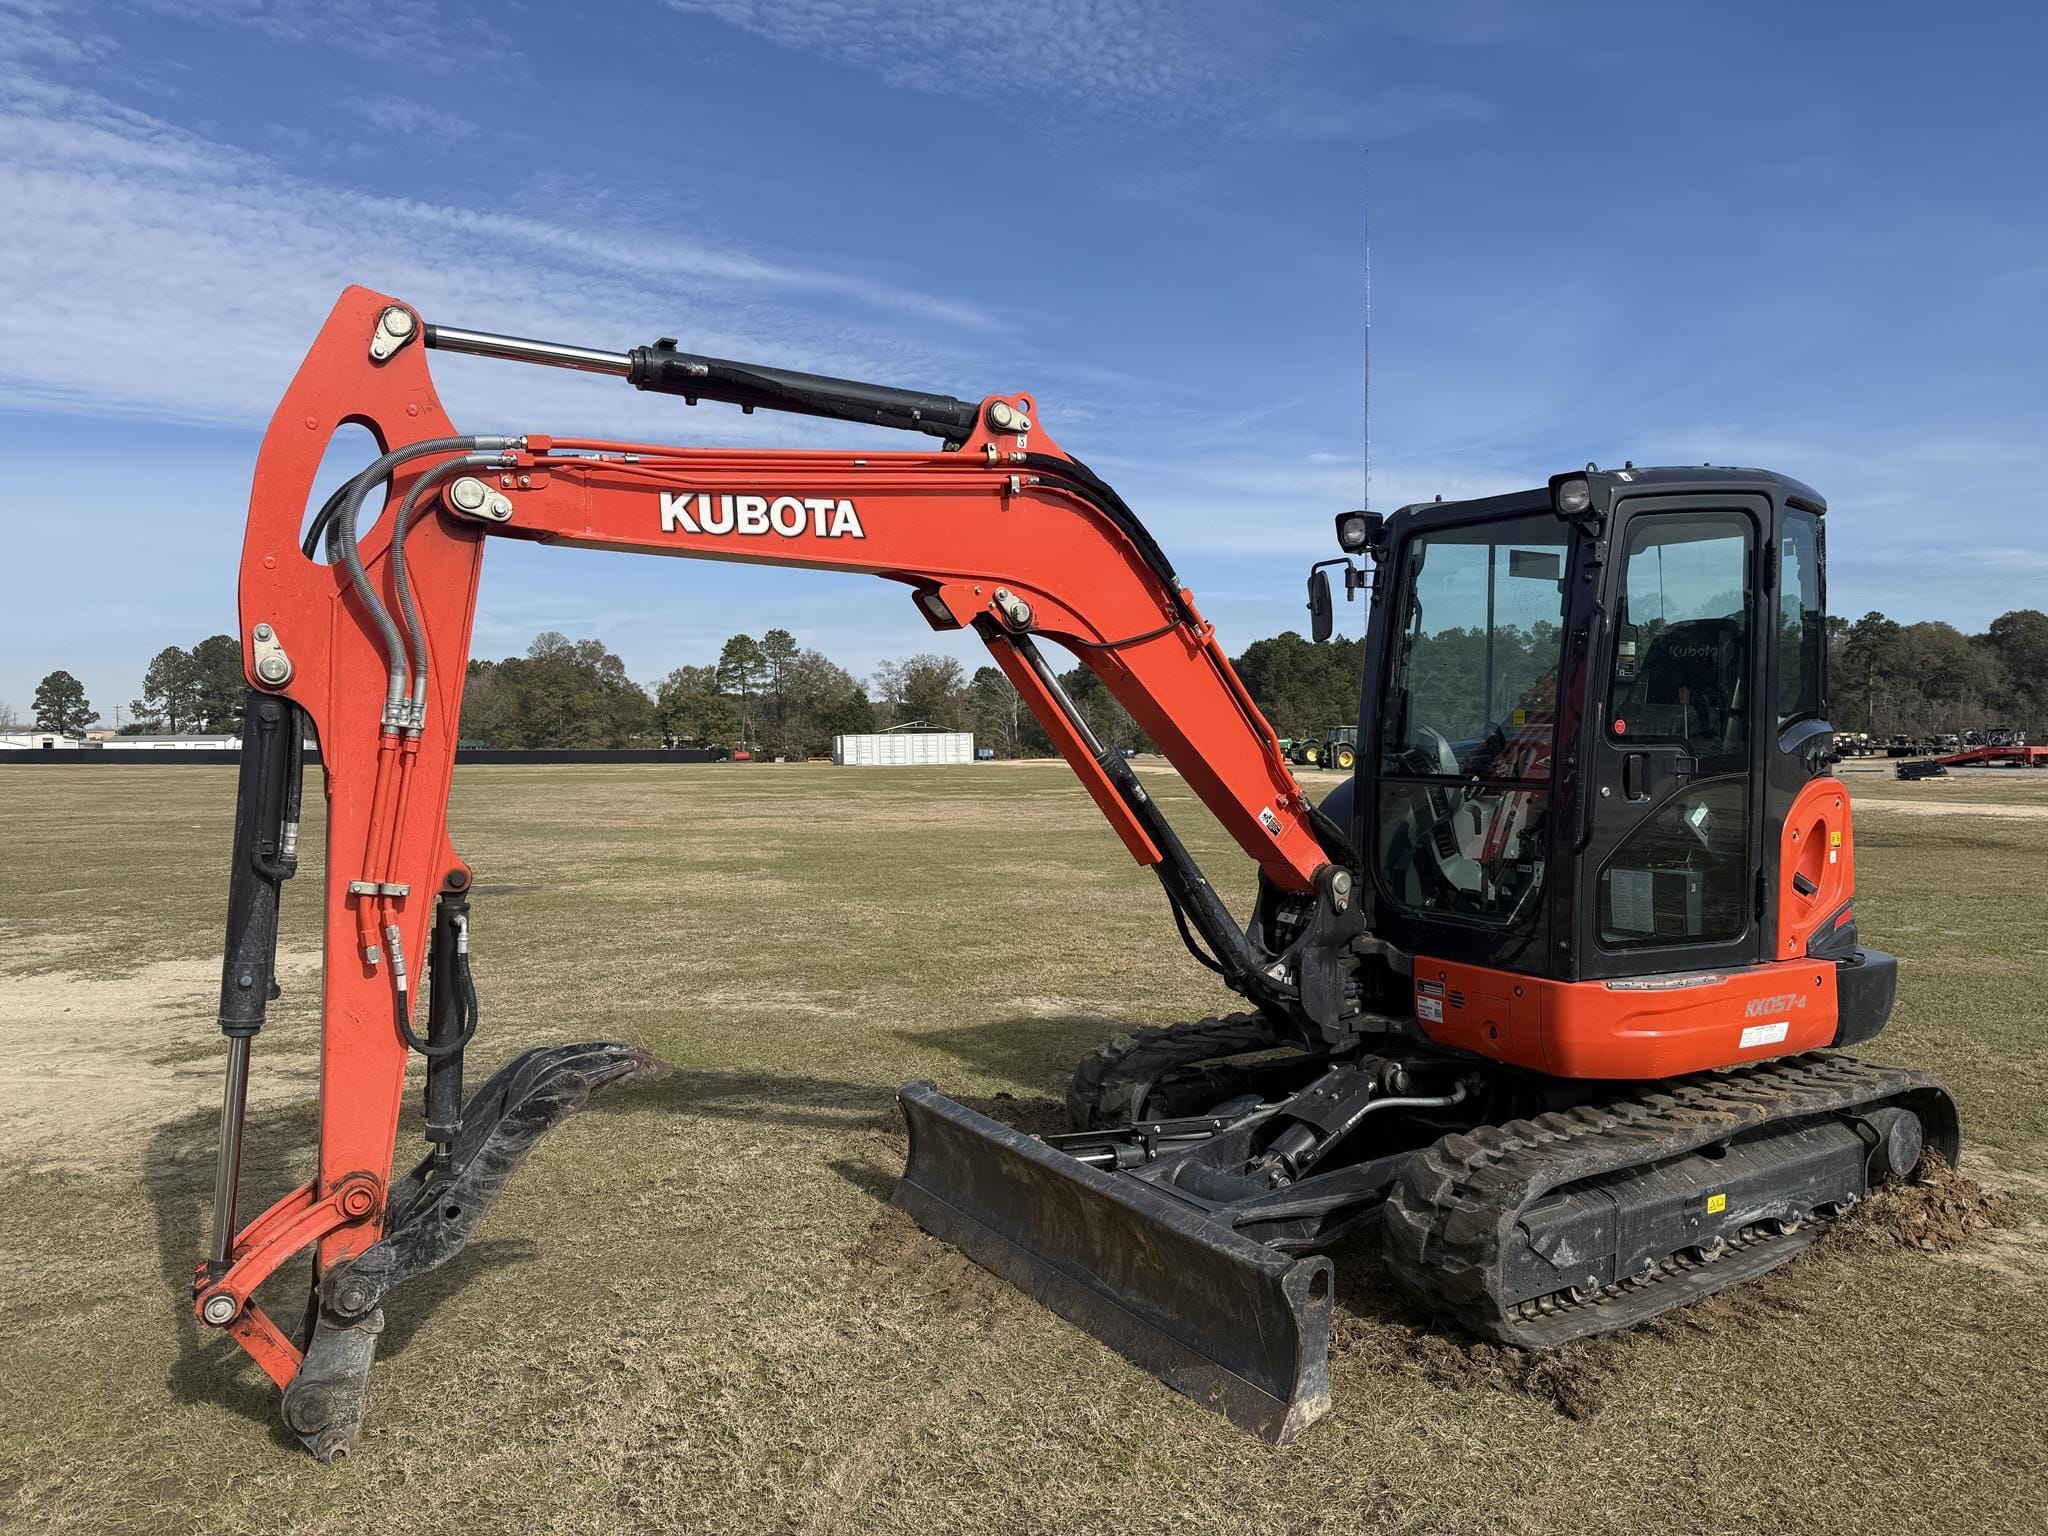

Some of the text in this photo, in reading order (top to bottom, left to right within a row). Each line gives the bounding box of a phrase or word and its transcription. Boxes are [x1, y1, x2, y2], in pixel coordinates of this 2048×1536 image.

[659, 491, 865, 538] KUBOTA
[1669, 644, 1718, 658] Kubota
[1744, 993, 1808, 1018] KX057-4
